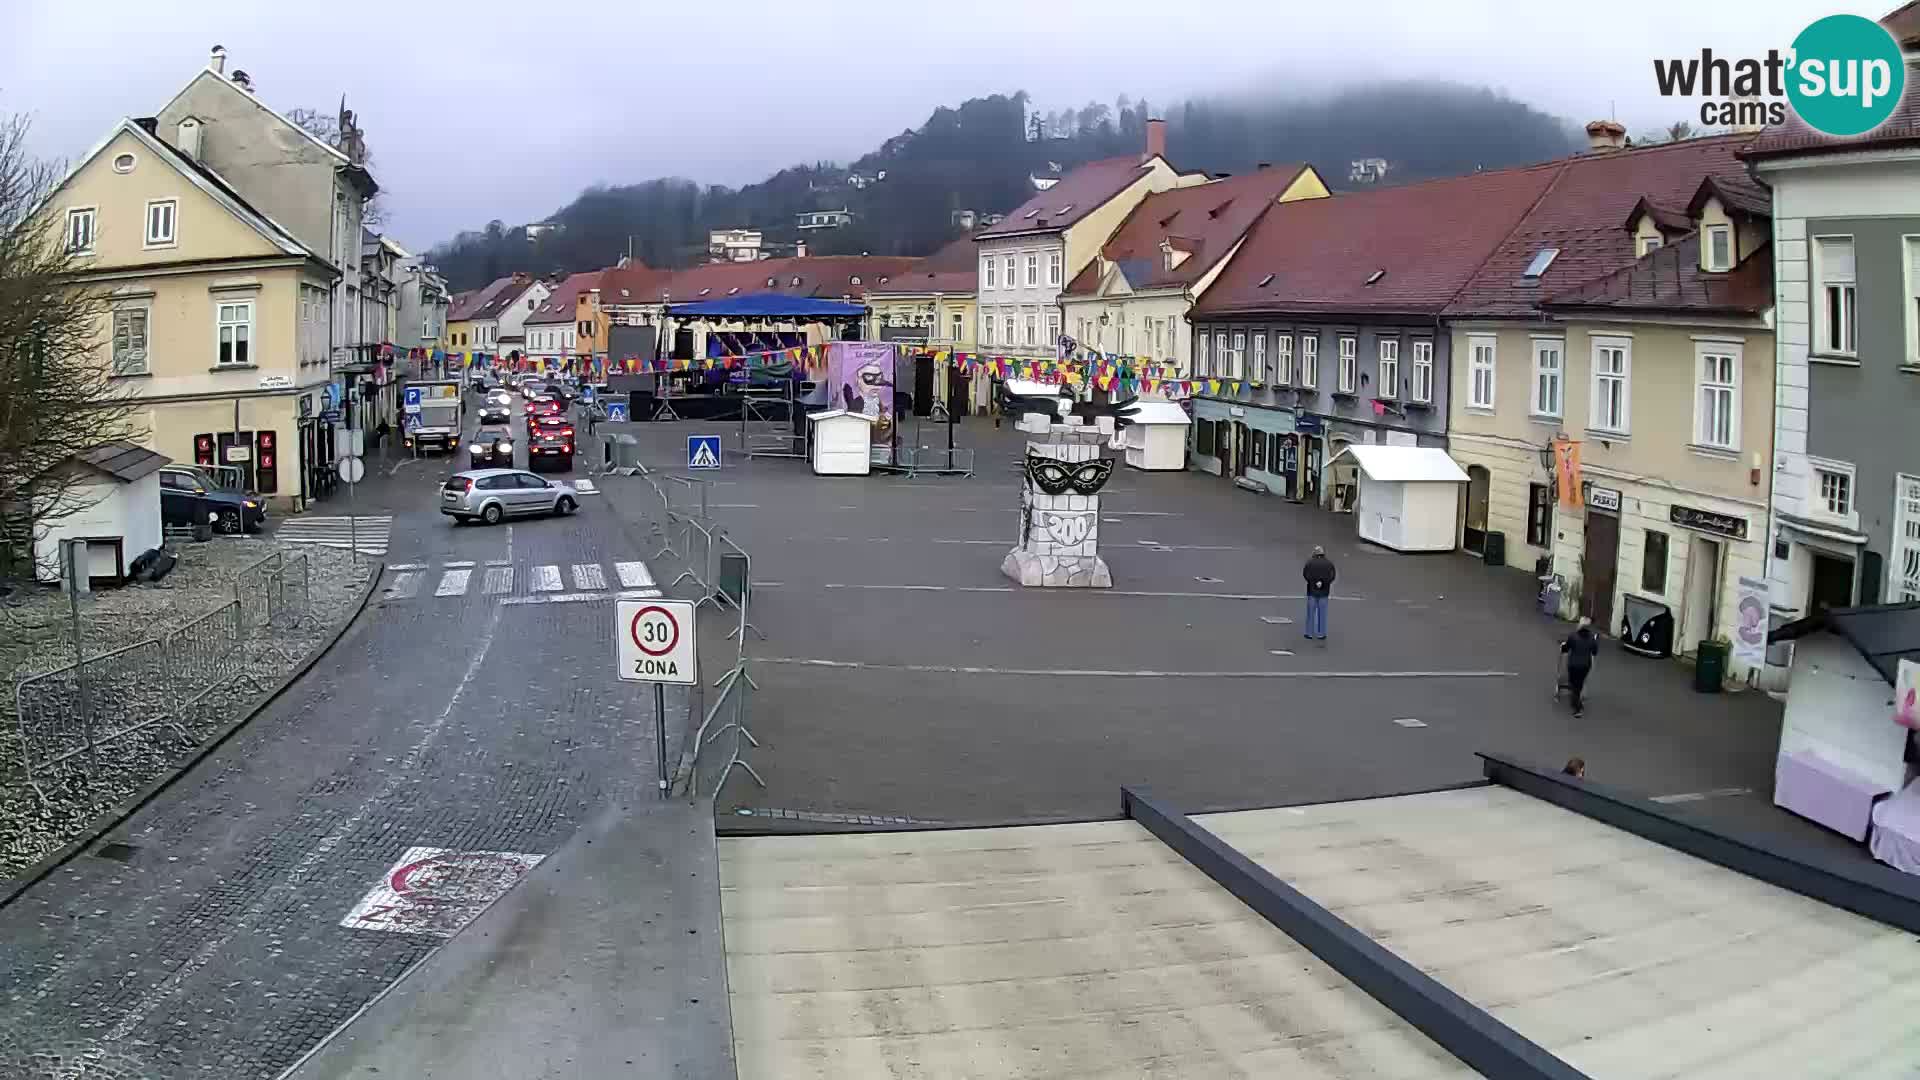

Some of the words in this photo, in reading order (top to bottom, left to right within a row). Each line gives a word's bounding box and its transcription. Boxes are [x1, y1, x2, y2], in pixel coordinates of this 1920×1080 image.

[409, 391, 417, 402] P
[1049, 518, 1088, 545] 200
[644, 622, 668, 643] 30
[634, 659, 679, 676] ZONA
